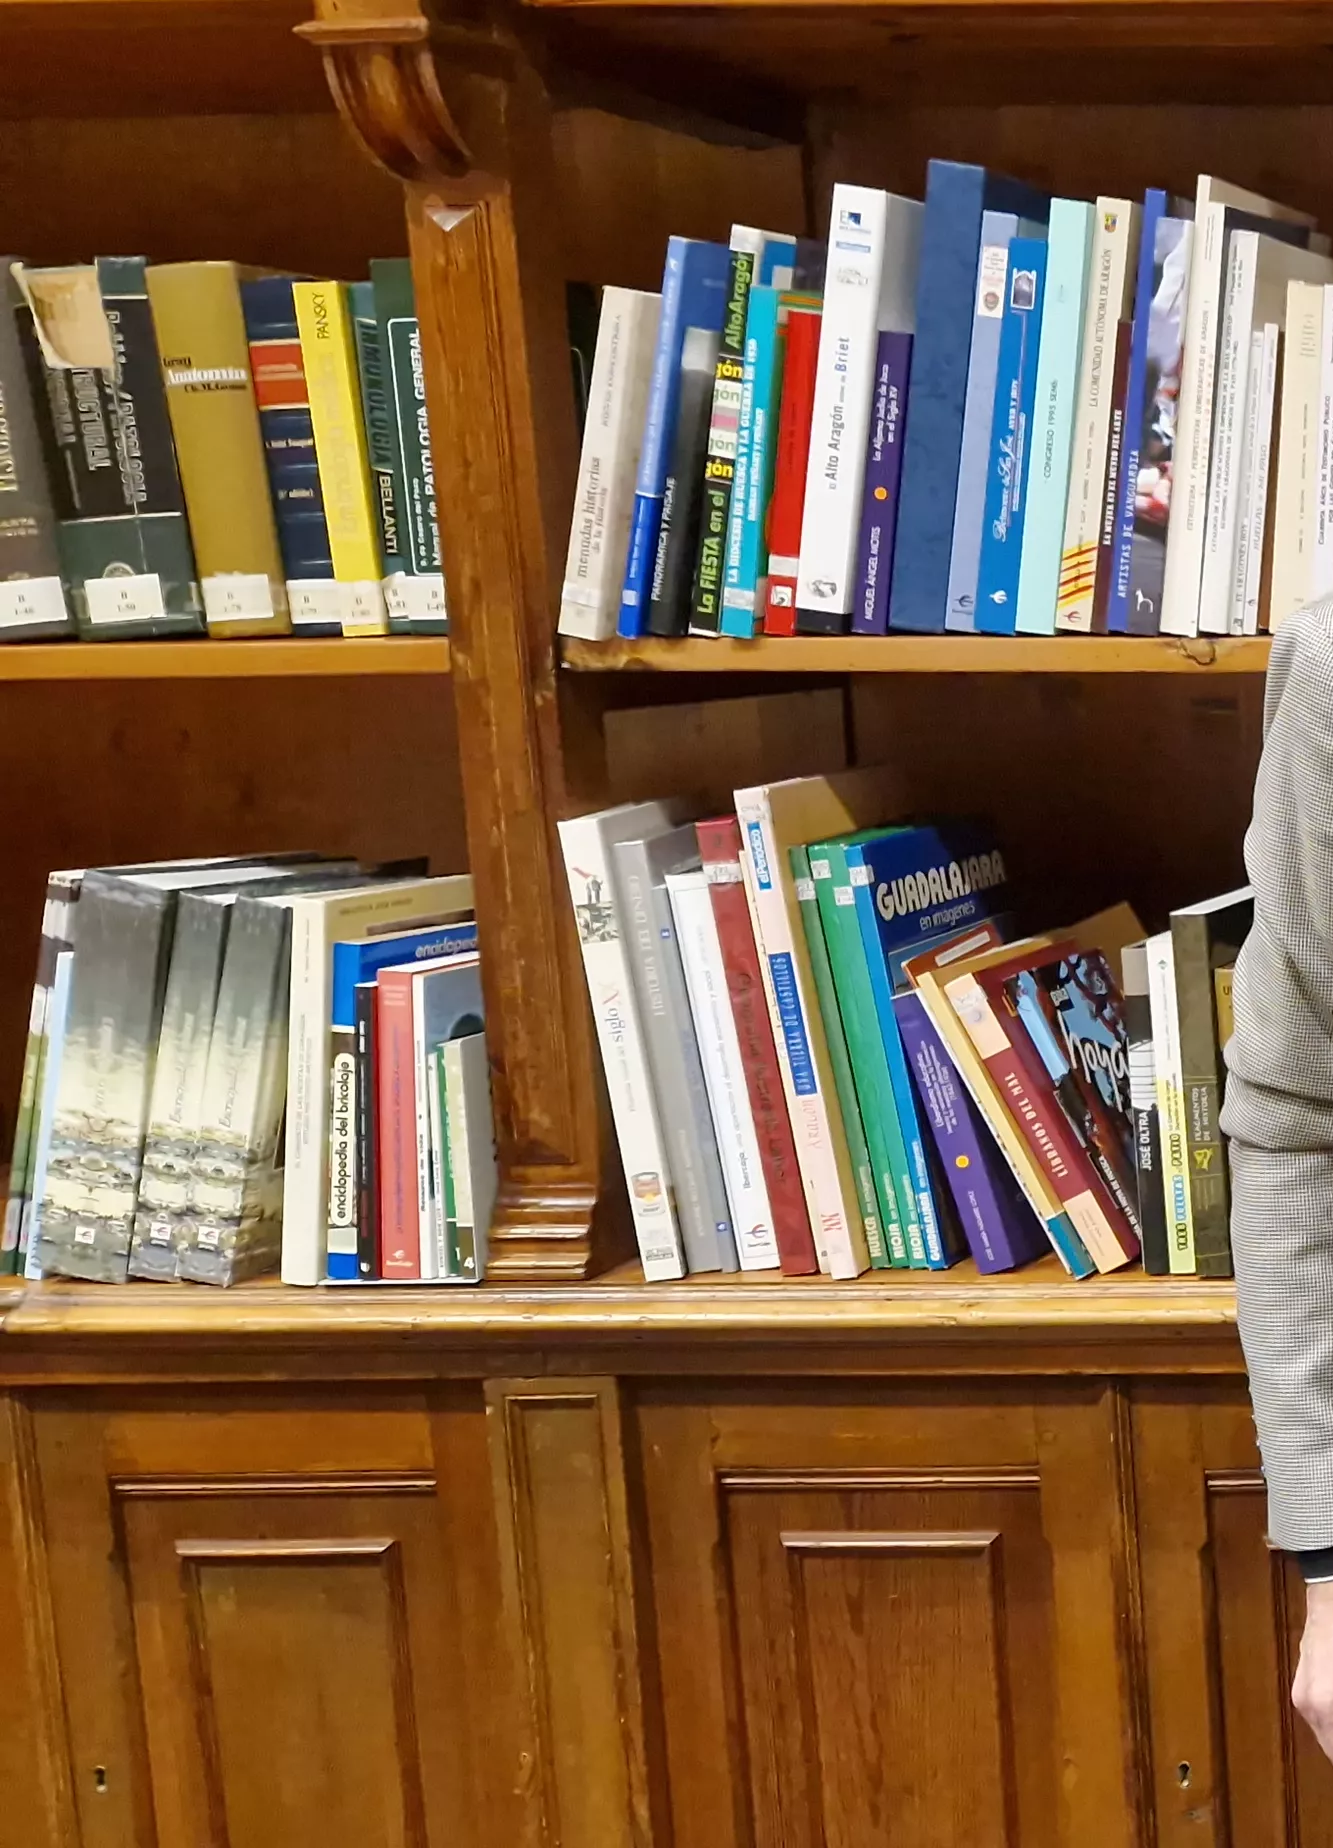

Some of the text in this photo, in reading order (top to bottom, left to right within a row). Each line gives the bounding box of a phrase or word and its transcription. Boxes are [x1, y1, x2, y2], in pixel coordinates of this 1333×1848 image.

[316, 291, 328, 339] PANSKY
[1088, 249, 1111, 407] LA COMUNIDAD AUTÓNOMA DE ARAGÓN
[408, 328, 425, 399] GENERAL
[824, 337, 849, 480] Alto Aragón Briet
[886, 400, 898, 442] en el Siglo
[727, 382, 753, 583] LA DE HUESCA Y LA GUERRA
[1042, 430, 1054, 477] CONGRESO
[380, 475, 399, 554] BELLANTI
[576, 456, 600, 578] menudas historias
[659, 477, 675, 529] Y PAISAJE
[1117, 450, 1139, 597] ARTISTAS DE VANGUARDIA
[696, 490, 725, 613] La FIESTA en el
[863, 526, 881, 619] MIGUEL MOTIS
[876, 849, 1005, 922] GUADALAJARA
[920, 915, 932, 930] en
[644, 956, 664, 1016] HISTORIA
[603, 1007, 626, 1042] siglo
[772, 957, 810, 1090] UNA TIERRA DE CASTILLOS
[333, 1061, 353, 1218] enciclopedia del bricolaje
[1004, 1072, 1068, 1177] LÍBRANOS DEL MAL
[1139, 1112, 1151, 1170] JOSÉ OLTRA
[1199, 1086, 1209, 1139] DE HISTORIA
[1098, 1154, 1115, 1180] HUESCA
[864, 1216, 881, 1257] HUESCA
[887, 1222, 904, 1258] RIOJA
[907, 1223, 924, 1259] RIOJA
[918, 1192, 940, 1261] GUADALAJARA
[464, 1257, 474, 1270] 4
